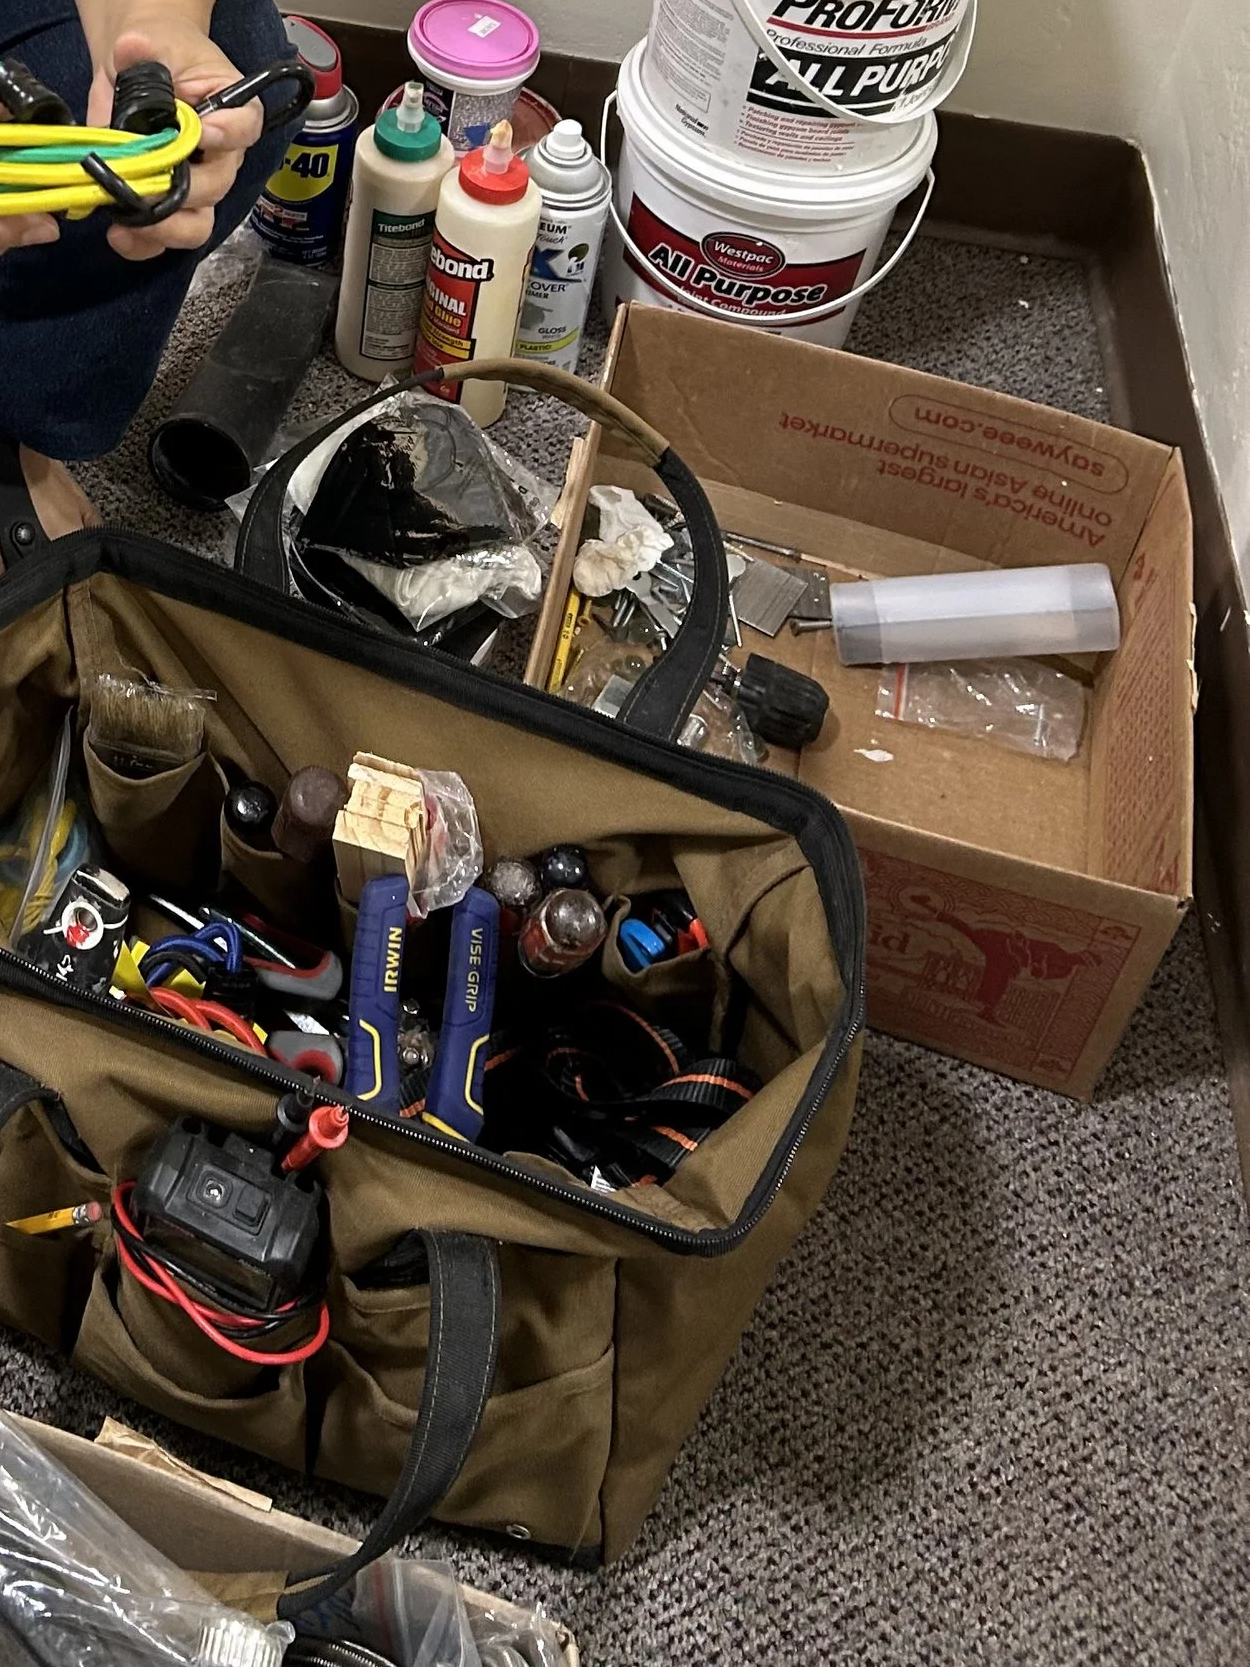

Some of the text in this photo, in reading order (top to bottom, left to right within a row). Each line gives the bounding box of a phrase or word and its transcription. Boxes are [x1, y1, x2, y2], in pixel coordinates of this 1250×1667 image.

[765, 28, 928, 56] Professional Formula
[765, 58, 844, 97] ALL
[279, 152, 330, 179] -40
[378, 217, 426, 234] Titebond
[714, 241, 775, 265] Westpac
[717, 255, 765, 273] Materials
[649, 243, 828, 307] All Purpose
[538, 326, 567, 335] GLOSS
[914, 405, 1106, 478] sayweee.com
[778, 411, 1113, 530] online Asian supermarket
[877, 459, 1106, 549] America's largest
[384, 927, 403, 992] IRWIN
